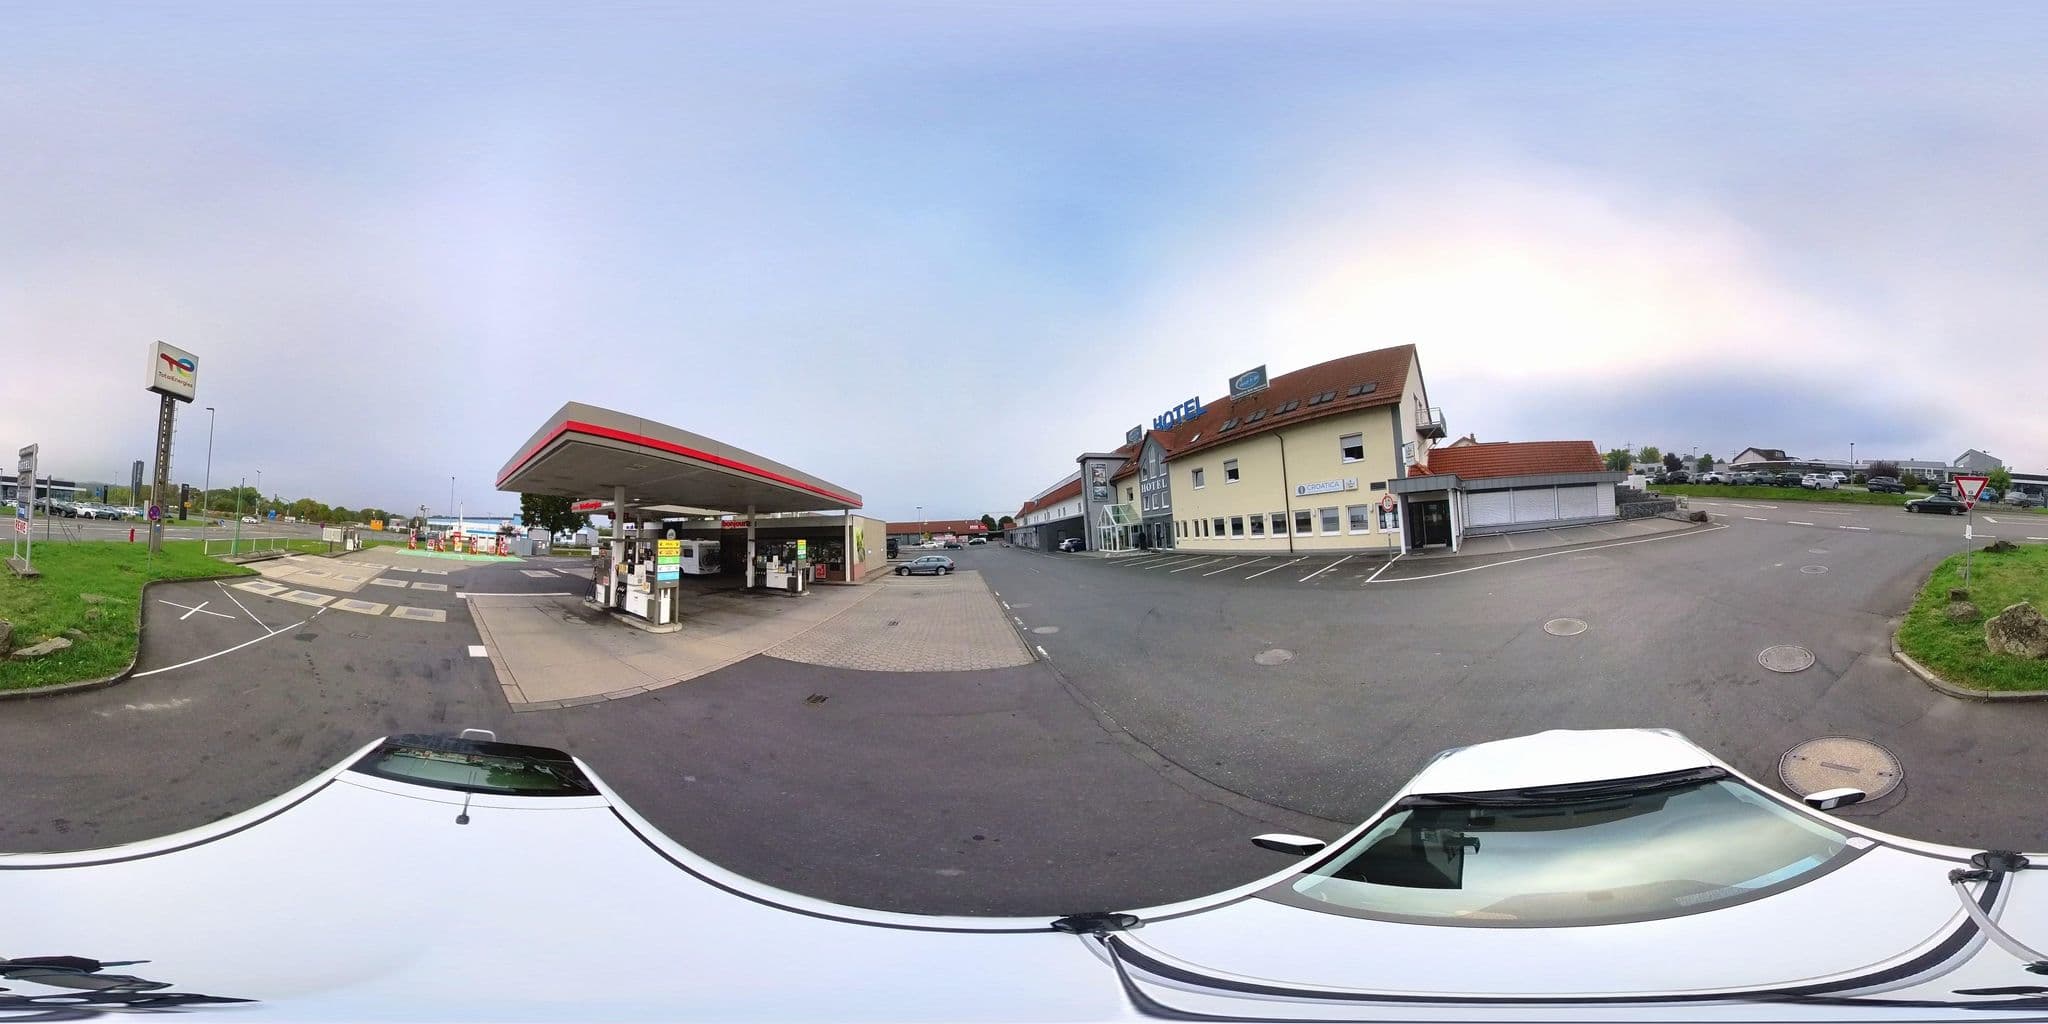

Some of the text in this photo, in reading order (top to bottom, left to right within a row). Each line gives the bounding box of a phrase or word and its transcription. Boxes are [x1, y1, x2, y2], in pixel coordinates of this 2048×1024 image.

[159, 371, 193, 388] TotalEnergies
[1153, 396, 1207, 431] HOTEL
[1141, 479, 1168, 493] HOTEL
[1307, 481, 1340, 491] CROATICA
